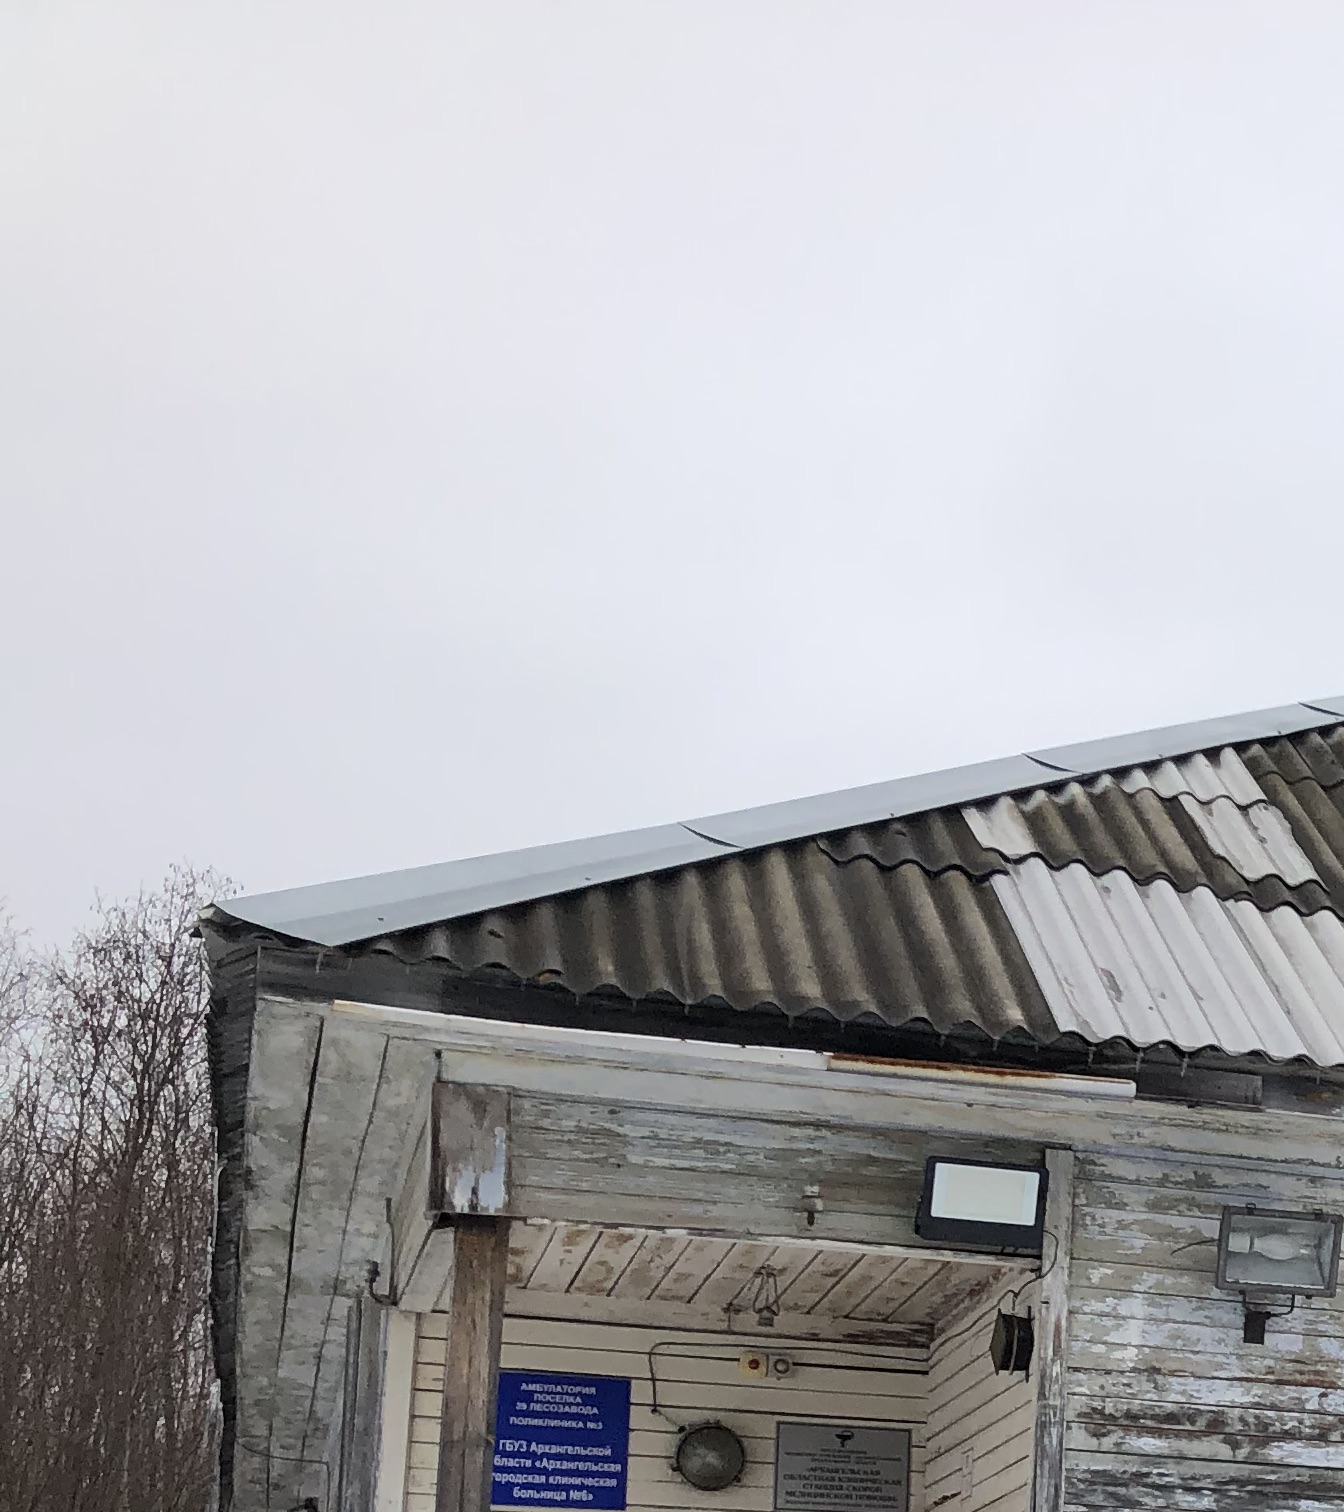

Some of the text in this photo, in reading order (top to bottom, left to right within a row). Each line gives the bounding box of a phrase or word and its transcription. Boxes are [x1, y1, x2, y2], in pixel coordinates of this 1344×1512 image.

[520, 1382, 596, 1395] АМБУЛАТОРИЯ
[533, 1393, 582, 1403] ПОСЕЛКА
[529, 1402, 599, 1415] ЛЕСОЗАВОДА
[509, 1416, 584, 1429] ПОЛИКЛИНИКА
[499, 1439, 612, 1456] ГБУЗ Архангельской
[493, 1454, 622, 1473] бласти «Архангельская
[548, 1475, 618, 1488] клиническая
[513, 1486, 567, 1501] больница
